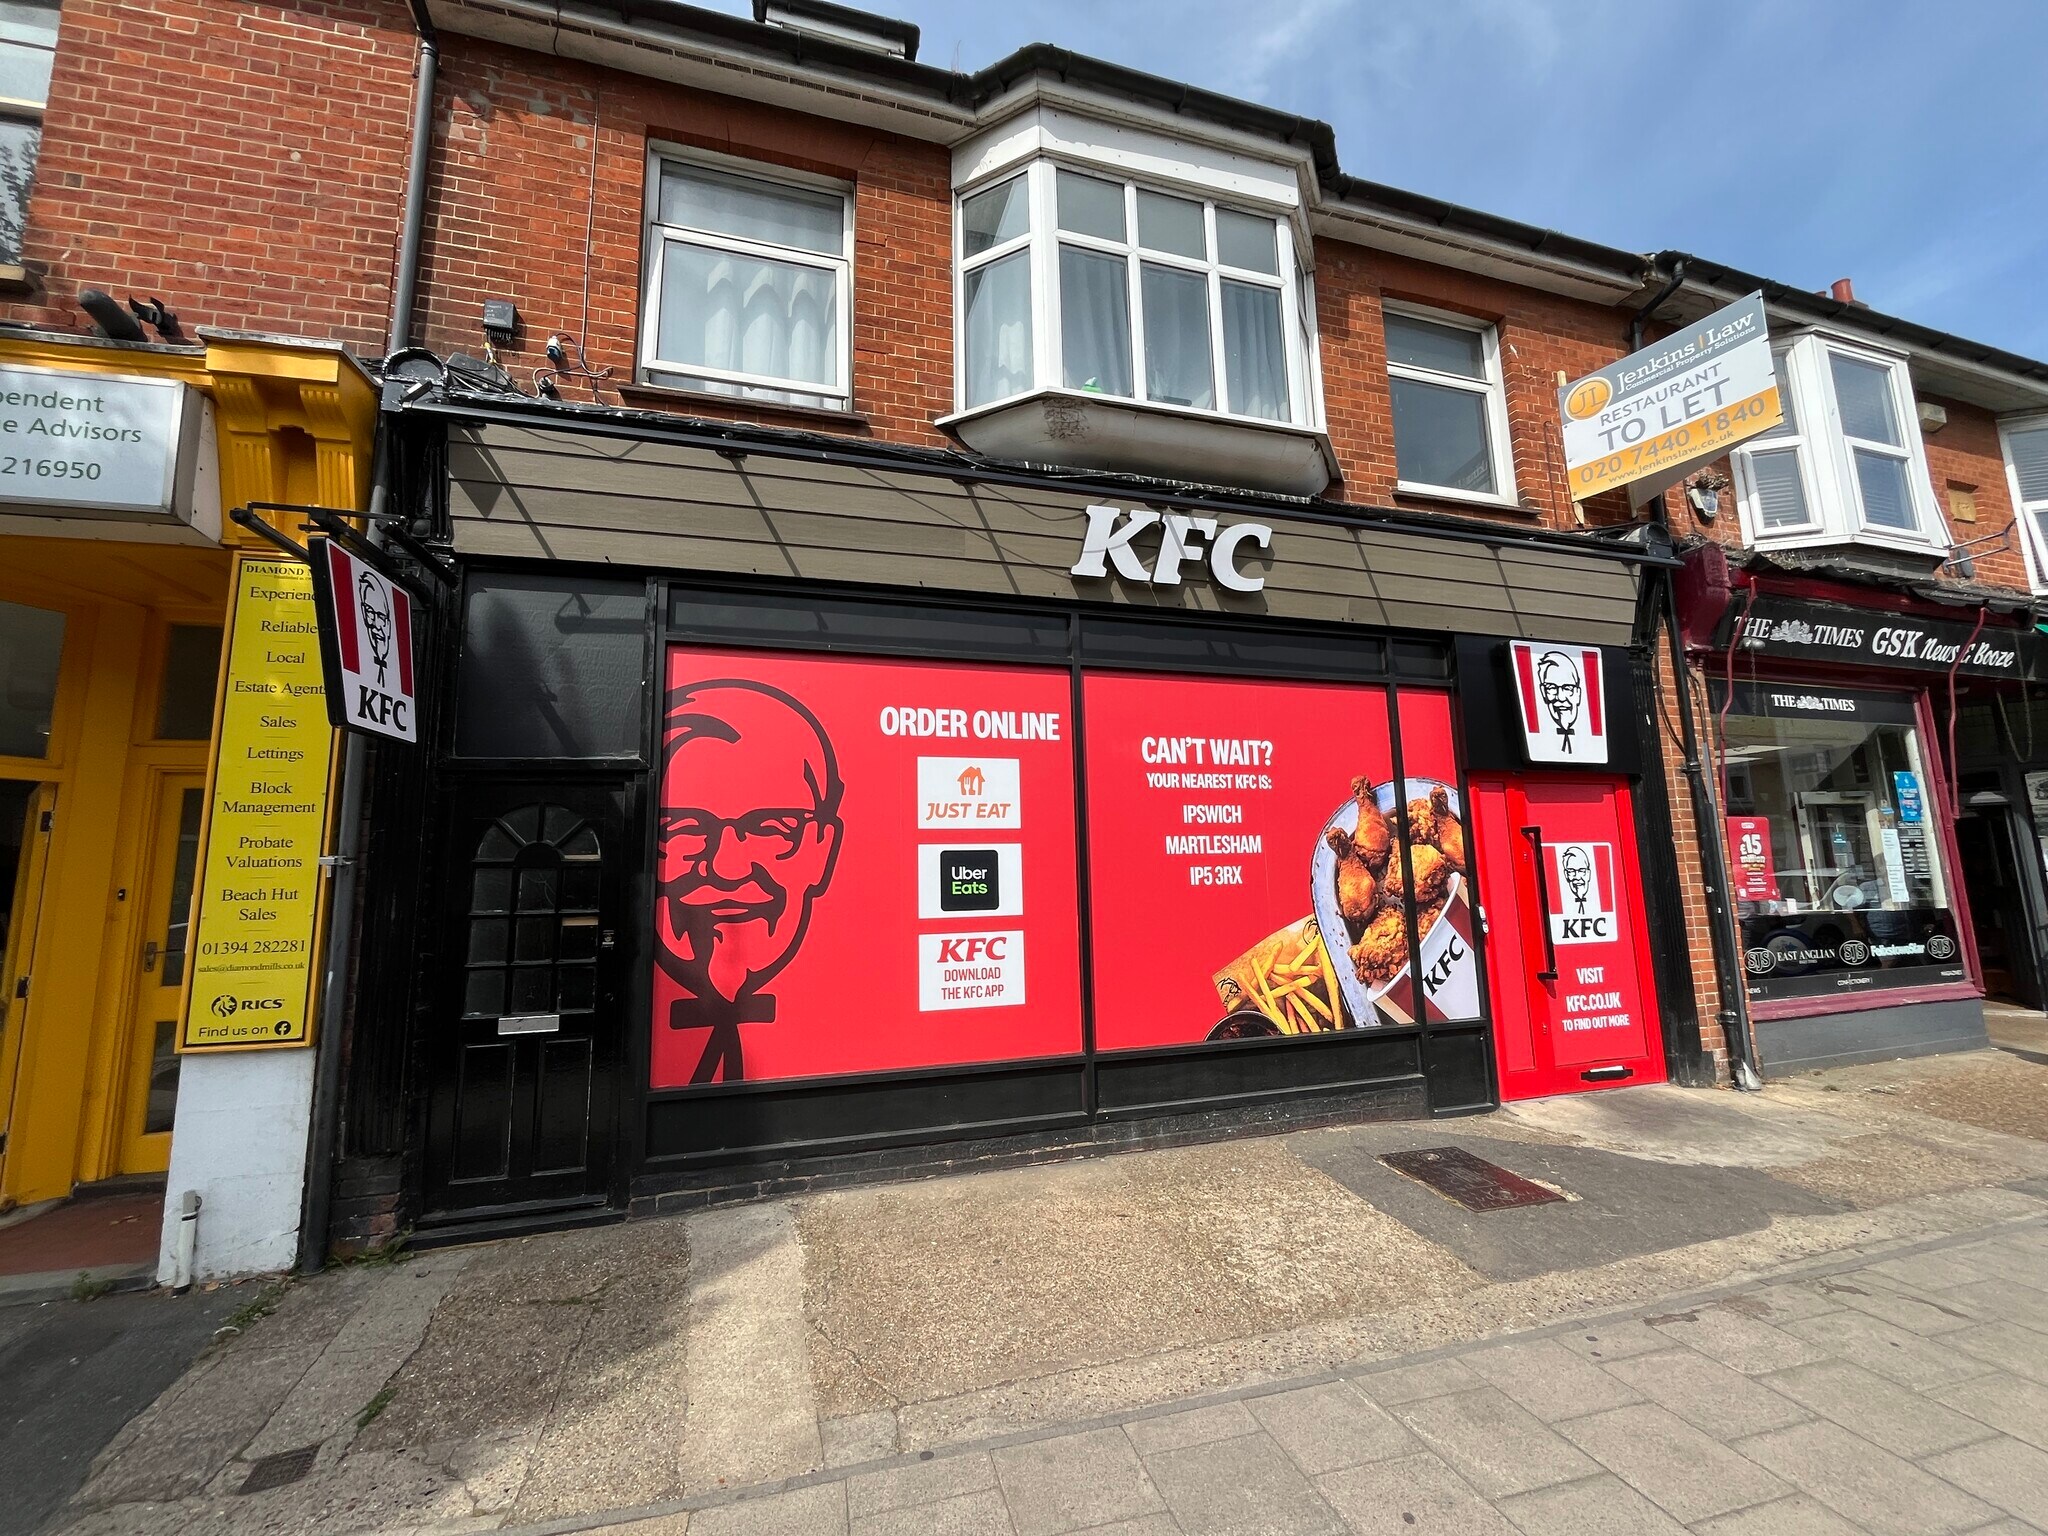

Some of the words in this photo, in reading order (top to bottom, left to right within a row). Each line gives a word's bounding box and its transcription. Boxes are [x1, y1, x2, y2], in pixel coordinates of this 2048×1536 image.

[1617, 342, 1695, 394] Jenkins
[1706, 312, 1754, 346] Law
[1625, 366, 1675, 391] Commercial
[1676, 346, 1713, 369] Property
[1714, 325, 1756, 350] Solutions
[1600, 362, 1722, 426] RESTAURANT
[1598, 417, 1646, 451] TO
[1660, 377, 1730, 430] LET
[27, 418, 142, 443] Advisors
[1580, 456, 1622, 483] 020
[1631, 429, 1690, 465] 7440
[1701, 397, 1765, 436] 1840
[1608, 430, 1734, 484] www.jenkinslaw.co.uk
[1, 456, 101, 480] 216950
[1070, 505, 1273, 592] KFC
[246, 565, 304, 576] DIAMOND
[261, 620, 318, 634] Reliable
[1813, 625, 1864, 648] TIMES
[1872, 627, 1924, 658] GSK
[1919, 638, 1960, 663] News
[1973, 642, 2015, 668] Booze
[266, 651, 305, 663] Local
[235, 681, 277, 693] Estate
[357, 684, 407, 731] KFC
[1771, 694, 1797, 708] THE
[1821, 698, 1855, 711] TIMES
[260, 715, 297, 728] Sales
[880, 706, 968, 738] ORDER
[973, 710, 1060, 741] ONLINE
[247, 747, 304, 762] Lettings
[1141, 736, 1206, 764] CAN'T
[1210, 738, 1273, 766] WAIT?
[250, 782, 293, 795] Block
[1146, 772, 1179, 788] YOUR
[1182, 773, 1233, 789] NEAREST
[1235, 774, 1257, 789] KFC
[1258, 775, 1272, 790] IS:
[222, 801, 316, 816] Management
[926, 803, 972, 821] JUST
[976, 803, 1011, 818] EAT
[1183, 805, 1242, 823] IPSWICH
[239, 836, 293, 849] Probate
[1166, 835, 1262, 854] MARTLESHAM
[1740, 834, 1762, 855] £15
[226, 856, 302, 868] Valuations
[951, 866, 987, 880] Uber
[1190, 866, 1212, 885] IP5
[1215, 866, 1242, 884] 3RX
[222, 889, 266, 901] Beach
[272, 888, 298, 900] Hut
[952, 881, 987, 894] Eats
[239, 908, 277, 921] Sales
[1562, 917, 1607, 939] KFC
[202, 941, 248, 955] 01394
[252, 940, 305, 954] 282281
[937, 937, 1007, 963] KFC
[1777, 951, 1797, 961] EAST
[1799, 949, 1835, 960] ANGLIAN
[944, 967, 1001, 982] DOWNLOAD
[1422, 934, 1465, 997] KFC
[1576, 967, 1604, 985] VISIT
[941, 987, 961, 1000] THE
[964, 985, 983, 999] KFC
[984, 984, 1004, 997] APP
[241, 999, 283, 1010] RICS
[1566, 992, 1622, 1013] KFC.CO.UK
[198, 1025, 228, 1037] Find
[232, 1027, 248, 1036] us
[252, 1026, 268, 1035] on
[1562, 1019, 1574, 1031] TO
[1573, 1017, 1592, 1031] FIND
[1593, 1015, 1609, 1029] OUT
[1609, 1014, 1630, 1027] MORE
